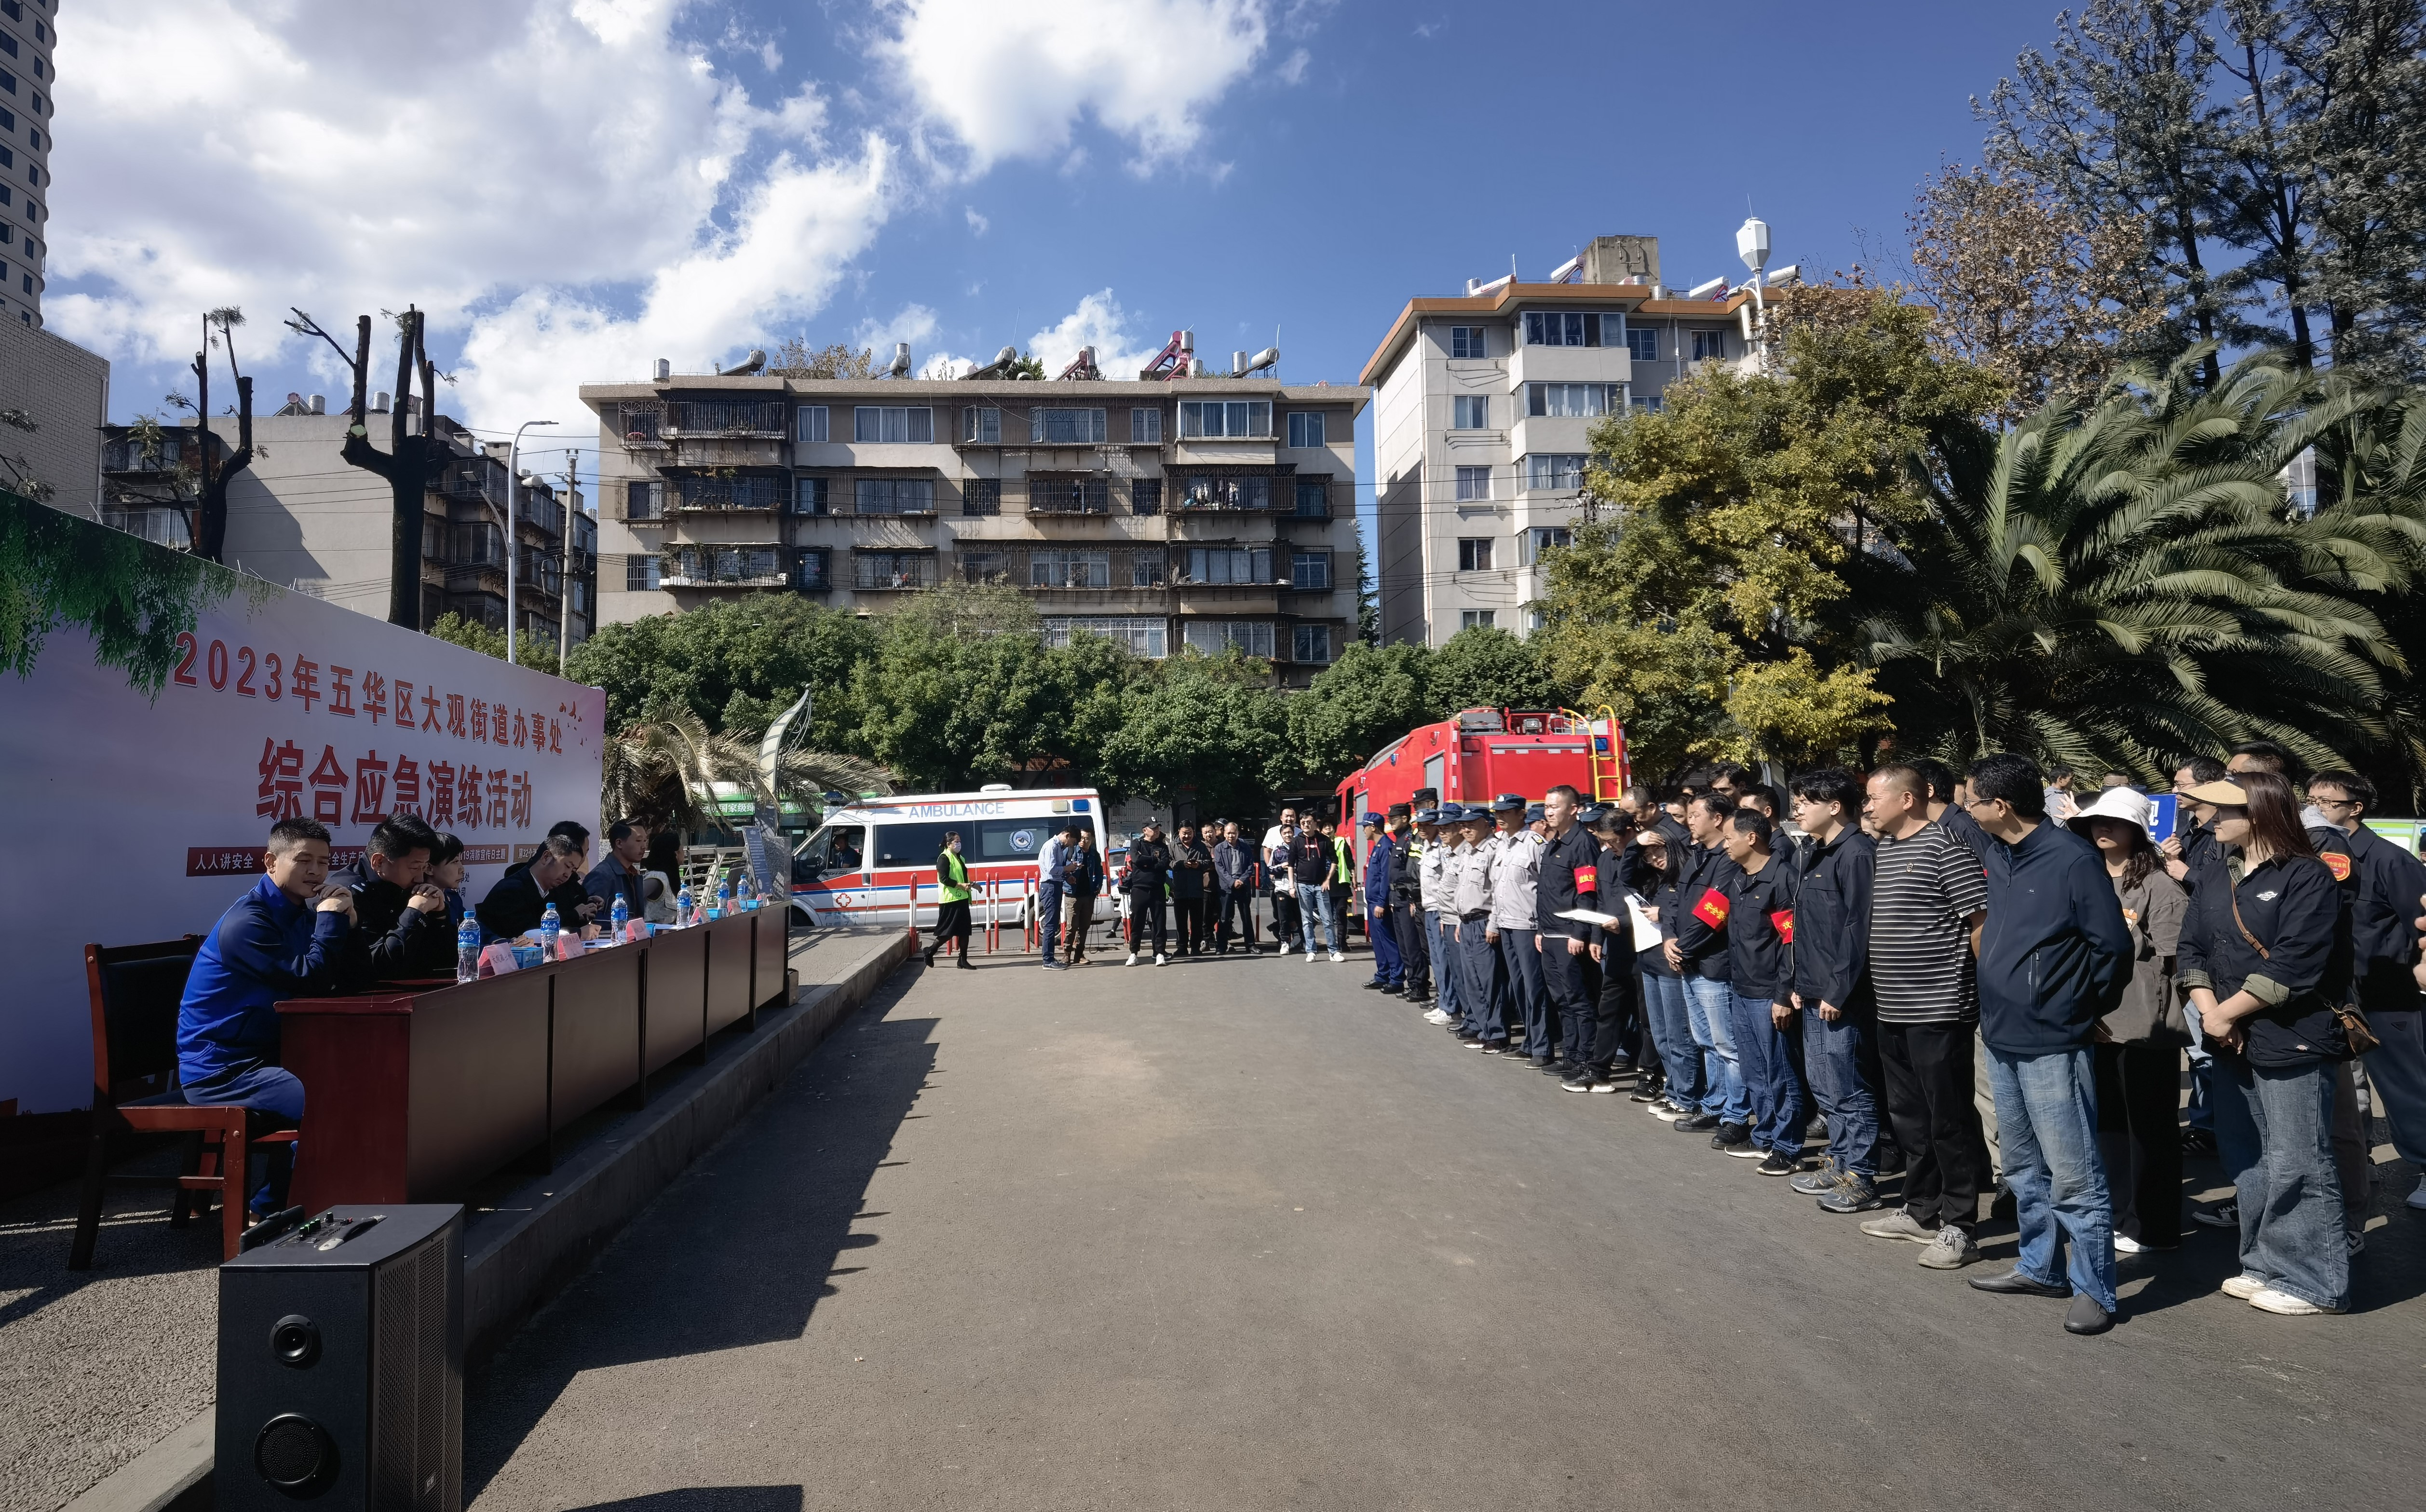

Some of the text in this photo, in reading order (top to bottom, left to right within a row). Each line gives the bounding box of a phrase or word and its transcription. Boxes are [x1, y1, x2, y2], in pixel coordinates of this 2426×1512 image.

[174, 632, 562, 755] 2023年五华区大观街道办事处
[256, 737, 531, 830] 综合应急演练活动
[908, 802, 1004, 818] AMBULANCE
[195, 852, 254, 870] 人人讲安全
